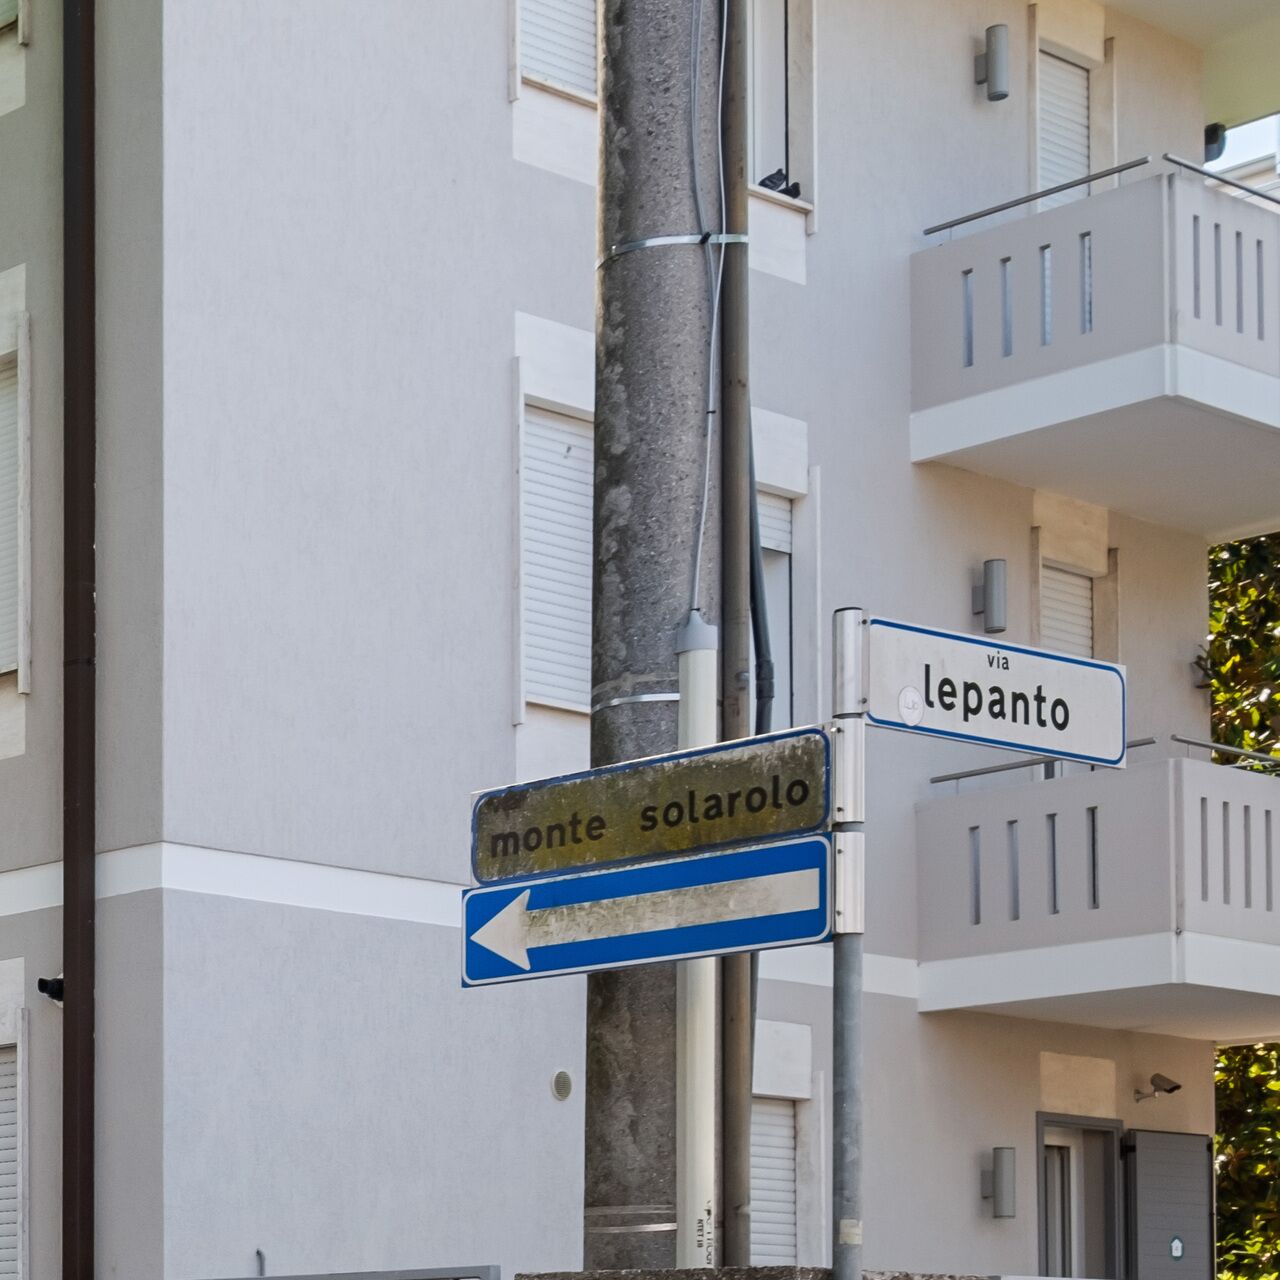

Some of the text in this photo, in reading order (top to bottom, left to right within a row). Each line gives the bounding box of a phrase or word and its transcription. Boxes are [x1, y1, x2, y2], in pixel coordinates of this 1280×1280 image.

[986, 650, 1010, 671] via
[924, 663, 1070, 732] lepanto
[490, 774, 810, 859] monte solarolo
